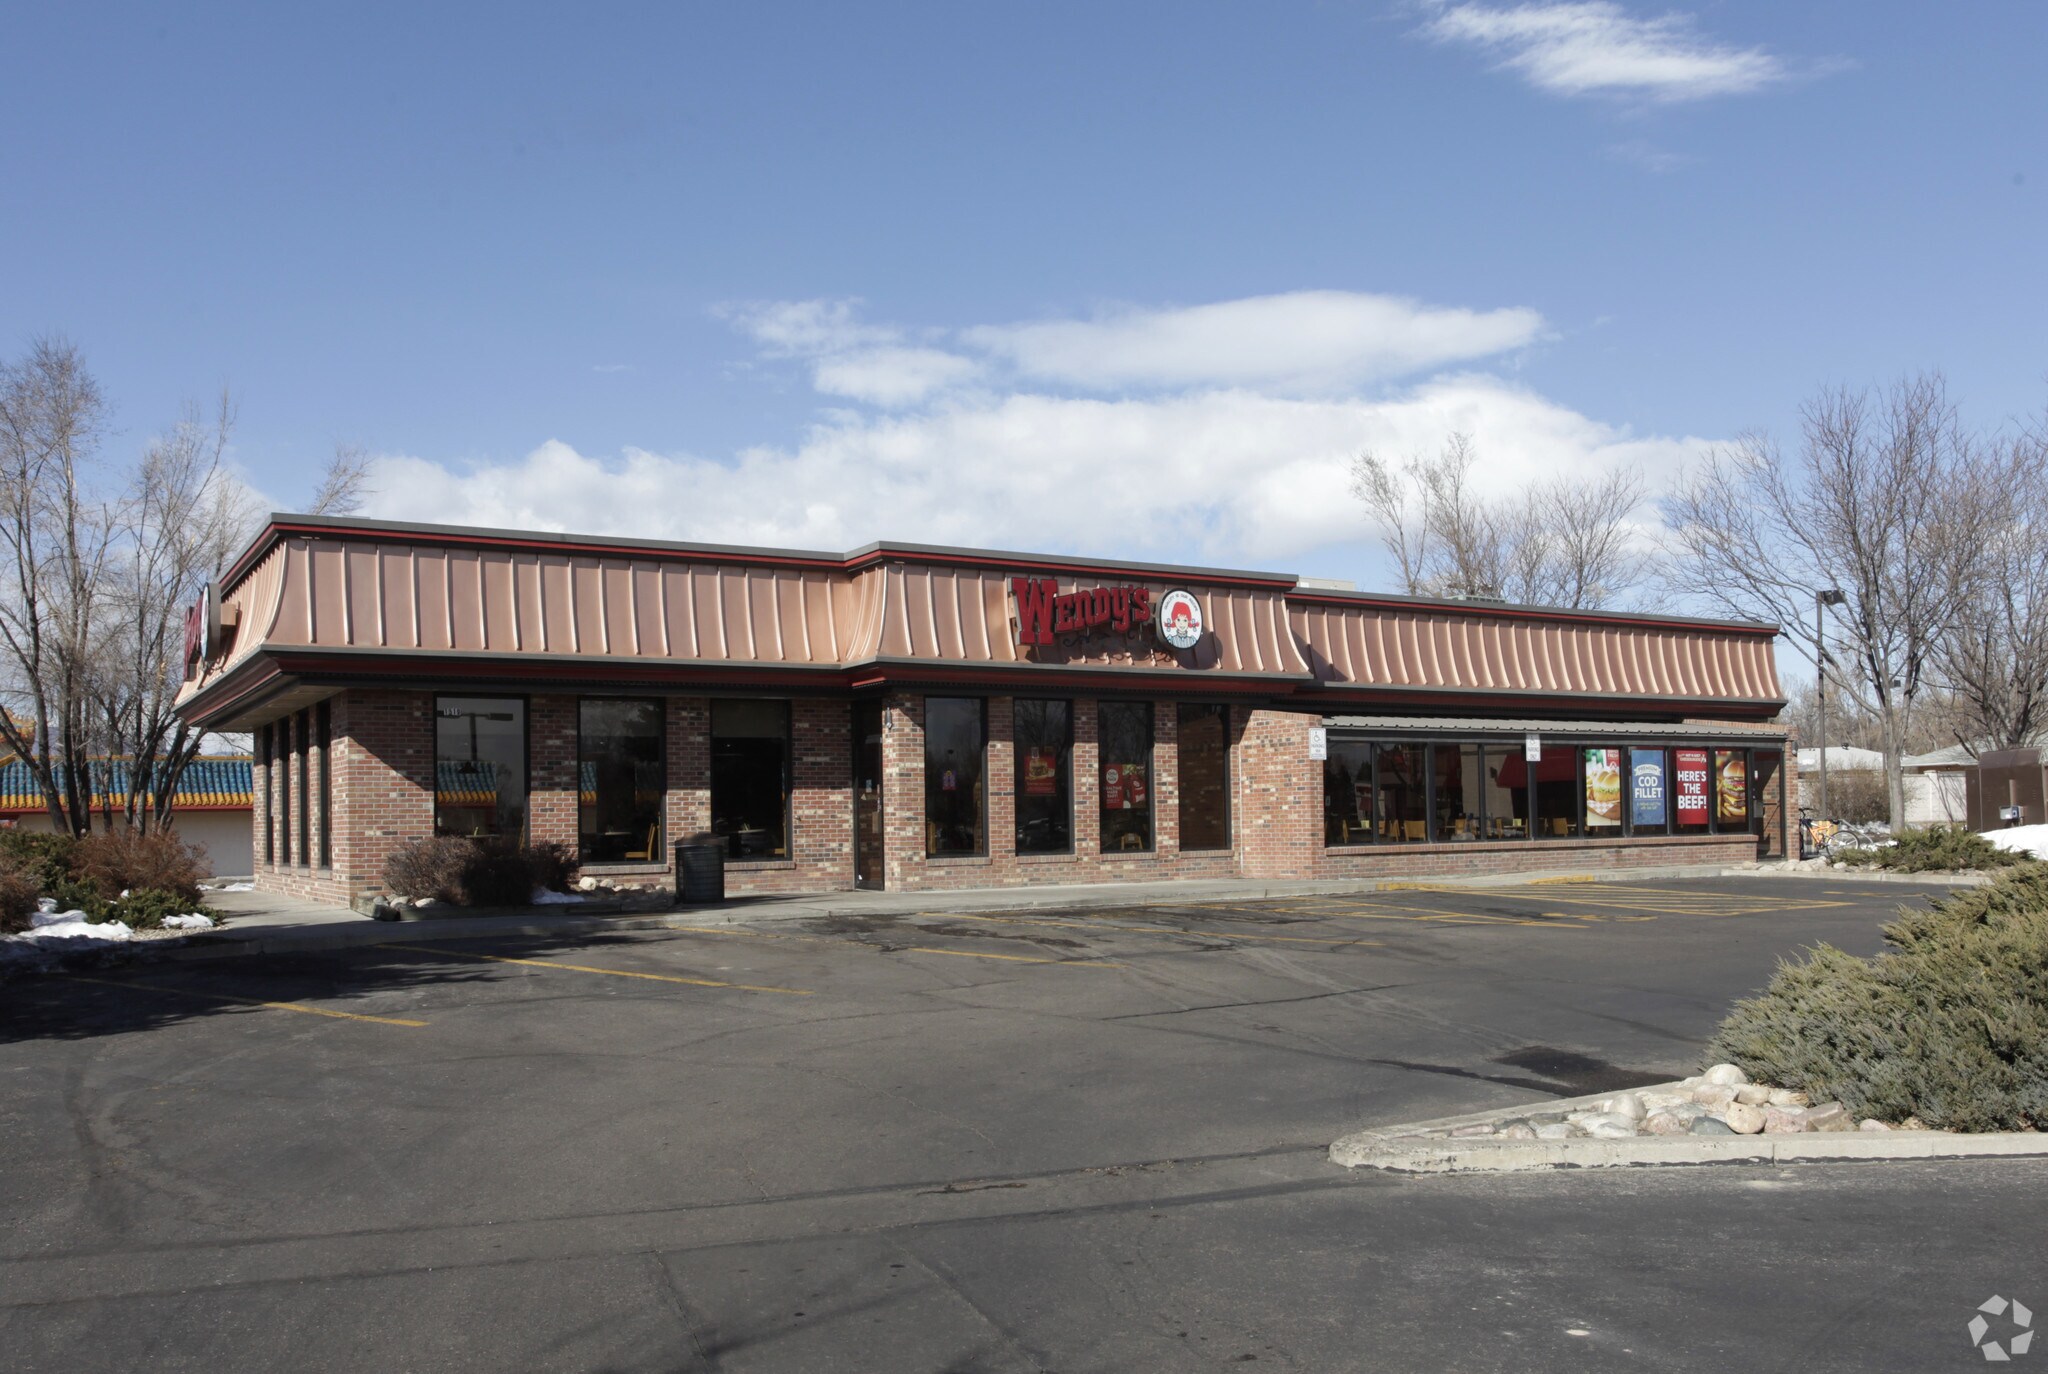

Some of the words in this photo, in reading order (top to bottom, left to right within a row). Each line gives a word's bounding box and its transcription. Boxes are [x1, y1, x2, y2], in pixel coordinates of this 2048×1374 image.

[1638, 776, 1658, 787] COD
[1677, 770, 1707, 782] HERE'S
[1634, 788, 1662, 798] FILLET
[1683, 783, 1701, 794] THE
[1677, 795, 1707, 809] BEEF!
